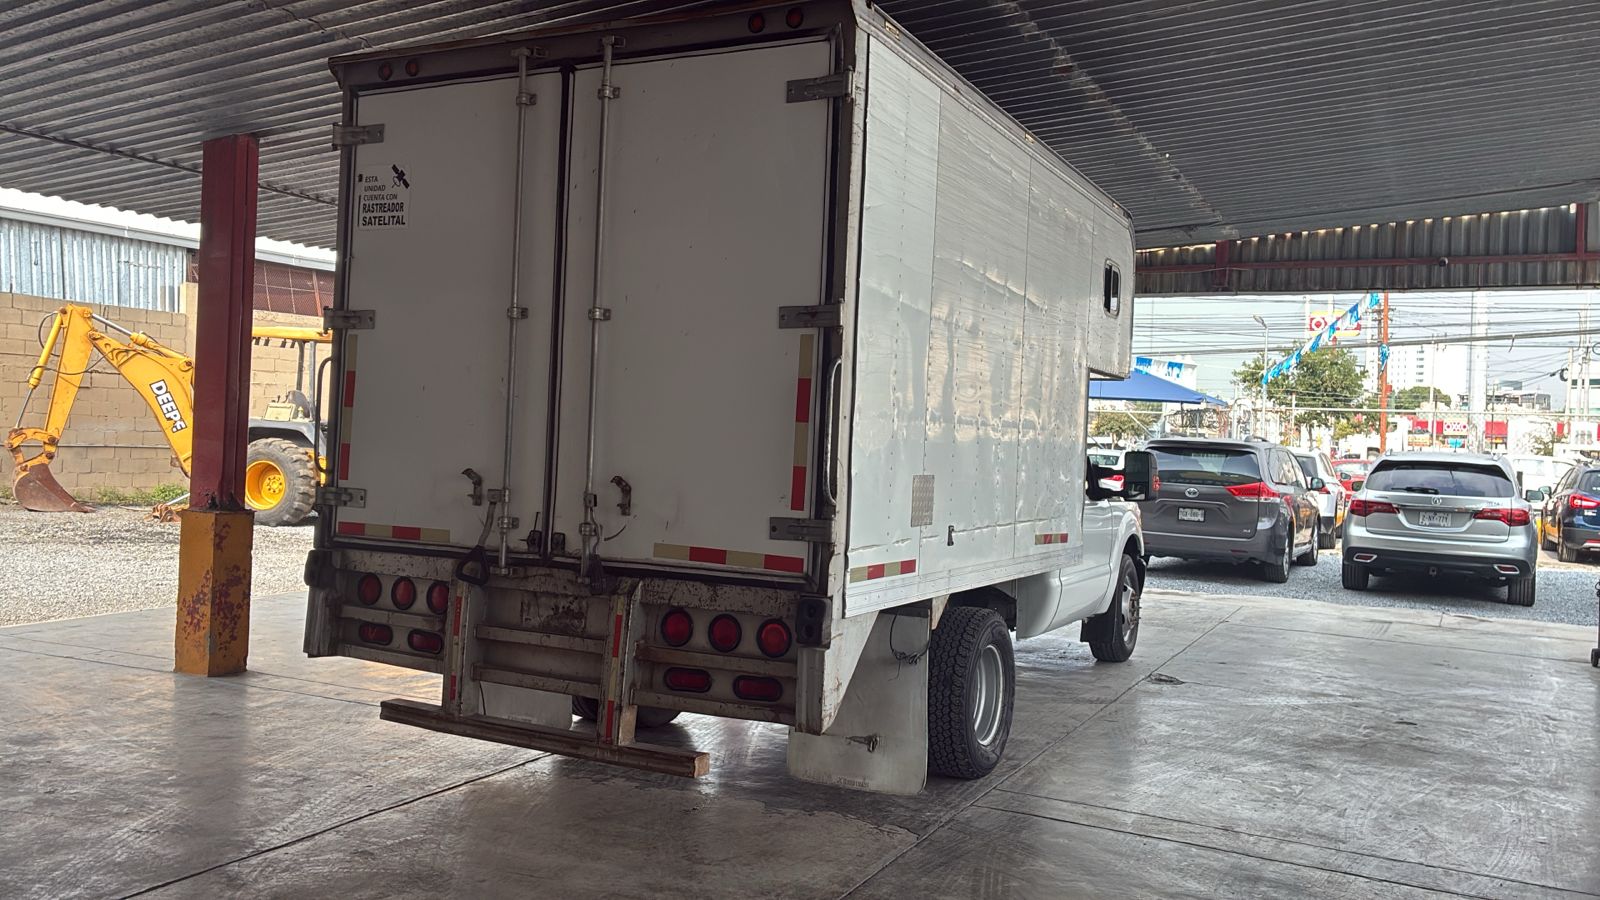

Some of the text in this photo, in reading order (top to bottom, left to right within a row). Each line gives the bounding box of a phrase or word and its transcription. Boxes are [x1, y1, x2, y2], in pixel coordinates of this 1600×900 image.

[364, 184, 386, 192] UNIDAD
[362, 202, 404, 213] RASTREADOR
[362, 215, 406, 226] SATELITAL
